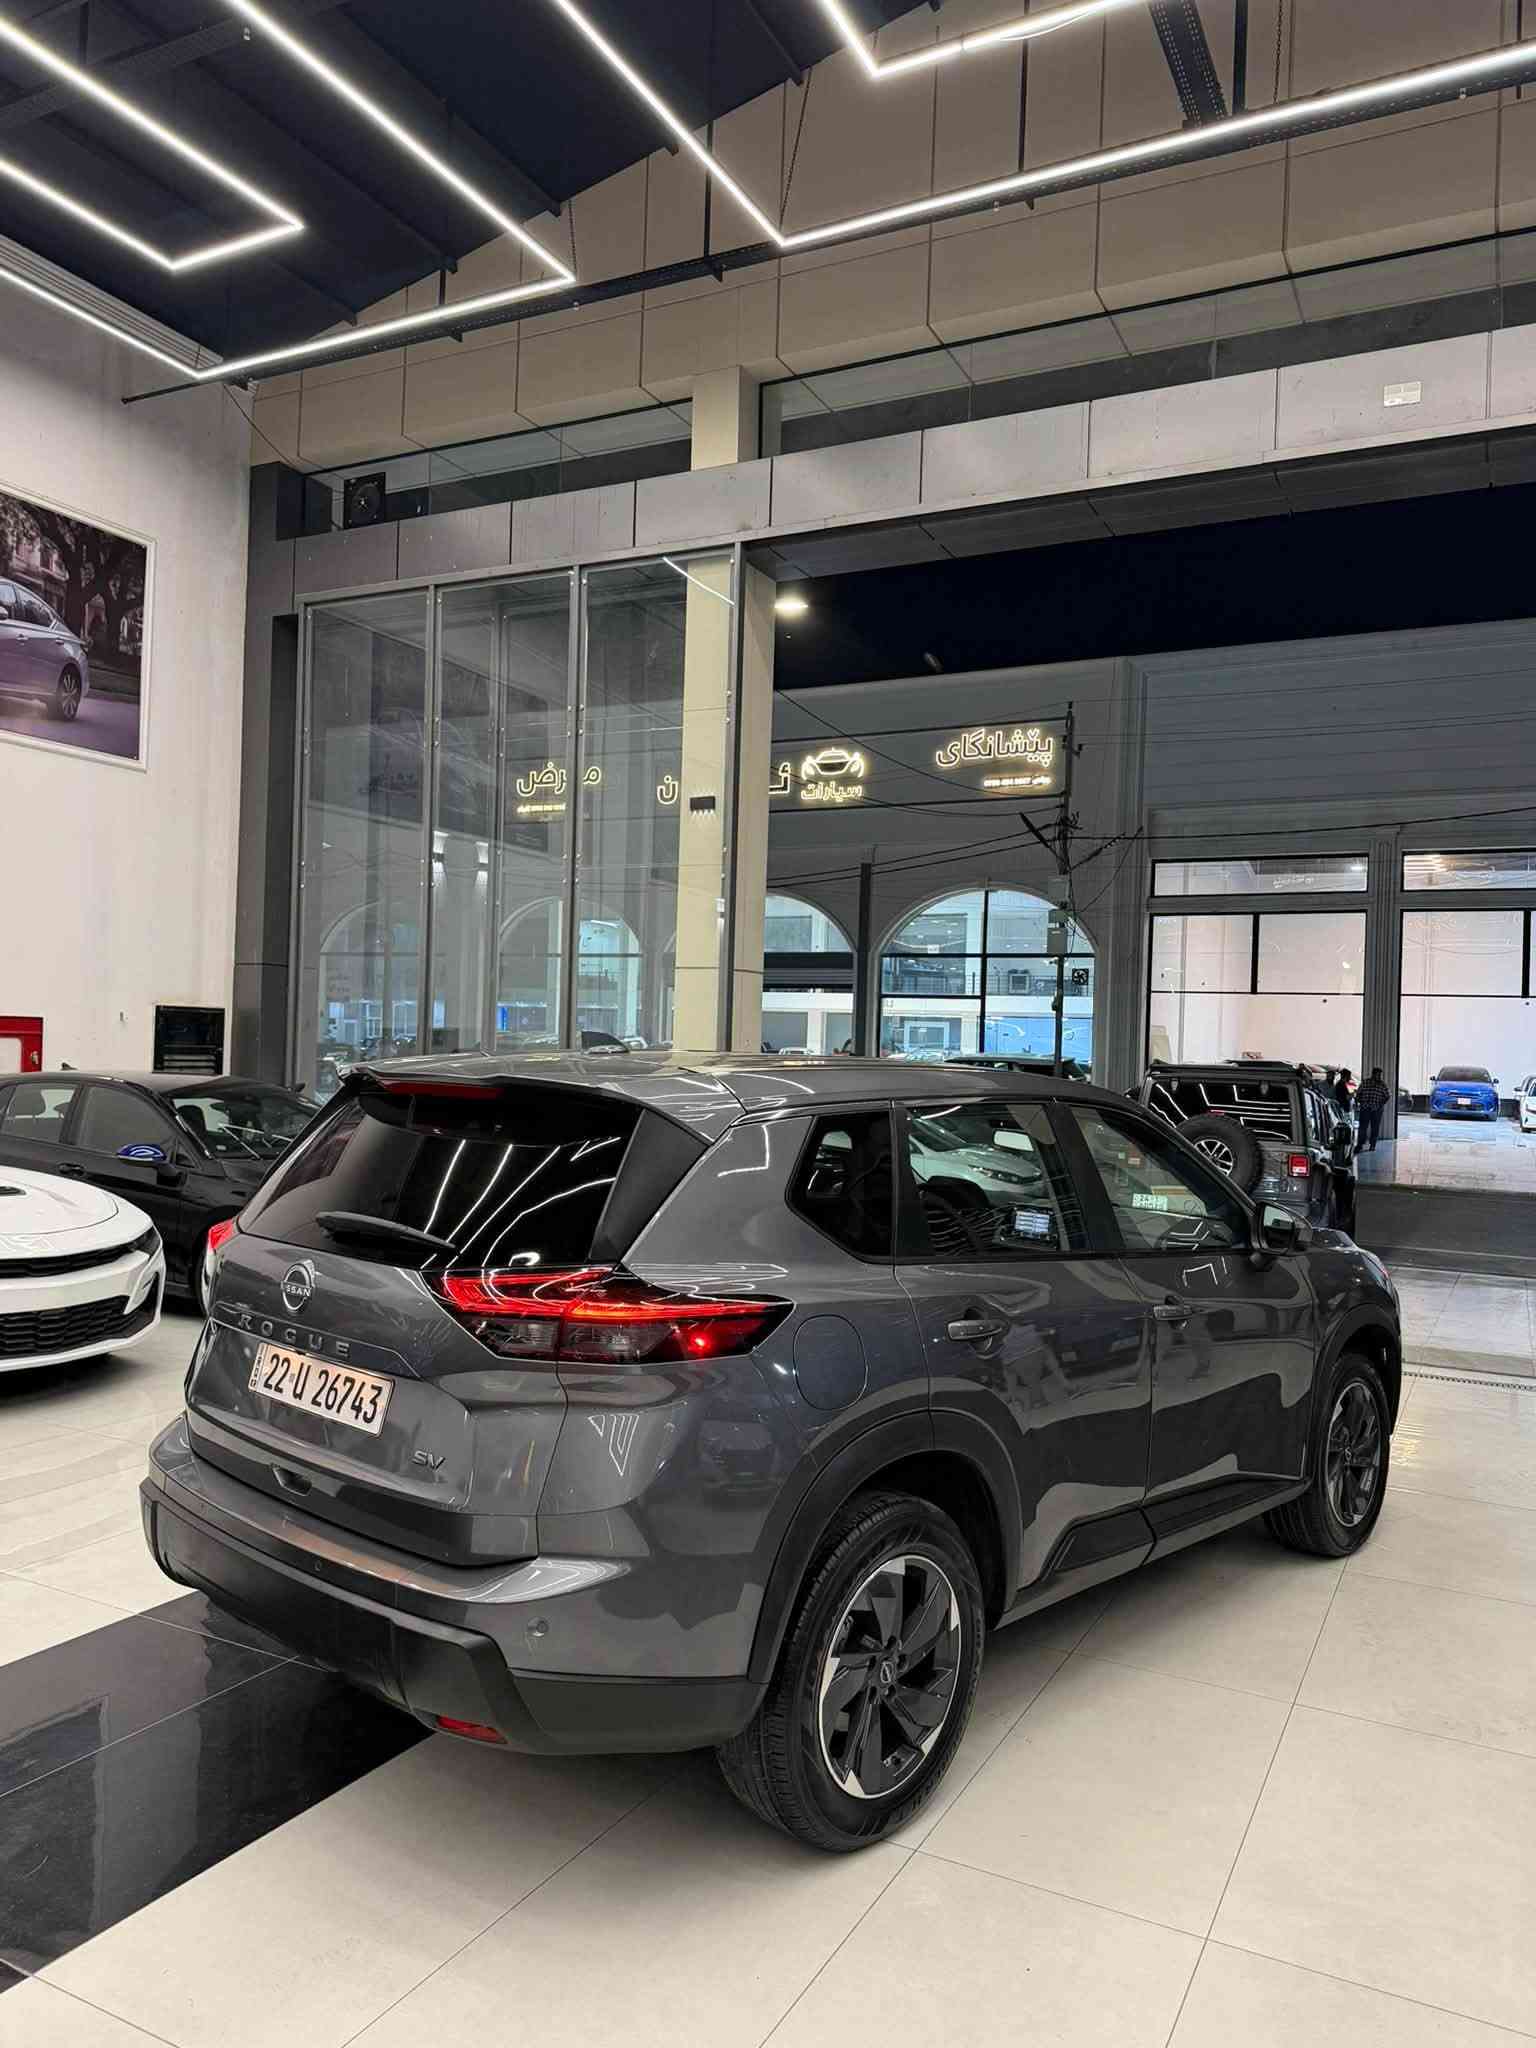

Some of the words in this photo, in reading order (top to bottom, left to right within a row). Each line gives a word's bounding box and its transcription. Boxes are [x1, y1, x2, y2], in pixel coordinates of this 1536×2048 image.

[516, 761, 601, 797] مرض
[238, 1314, 350, 1357] ROGUE
[264, 1353, 291, 1394] 22
[292, 1362, 312, 1401] U
[311, 1369, 383, 1424] 26743
[411, 1449, 446, 1472] SV
